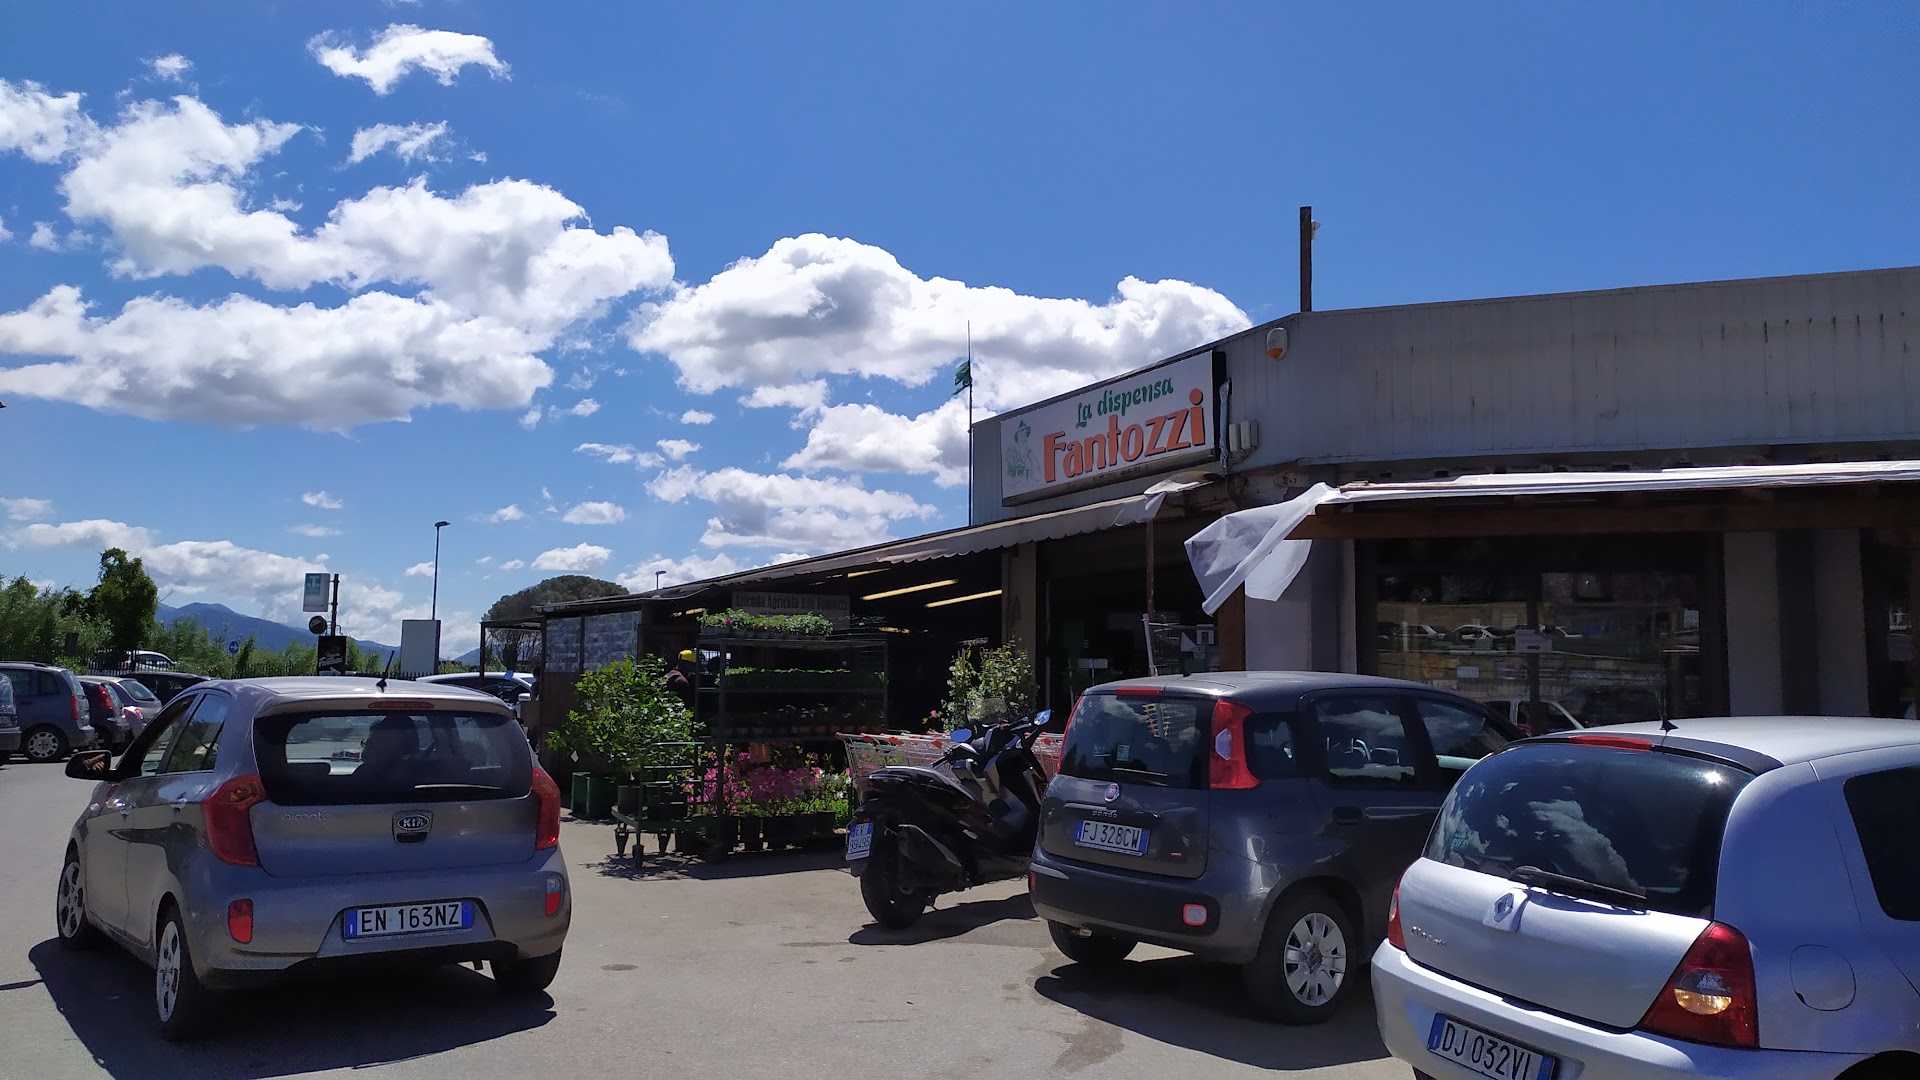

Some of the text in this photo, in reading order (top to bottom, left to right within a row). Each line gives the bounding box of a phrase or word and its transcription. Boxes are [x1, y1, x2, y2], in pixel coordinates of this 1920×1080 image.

[1076, 377, 1174, 428] La dispensa
[1043, 388, 1205, 483] Fantozzi
[403, 817, 425, 829] KIA
[1082, 823, 1098, 841] FJ
[1101, 825, 1140, 849] 328CW
[361, 903, 460, 933] EN 163NZ
[1442, 1023, 1531, 1080] DJ 032VI
